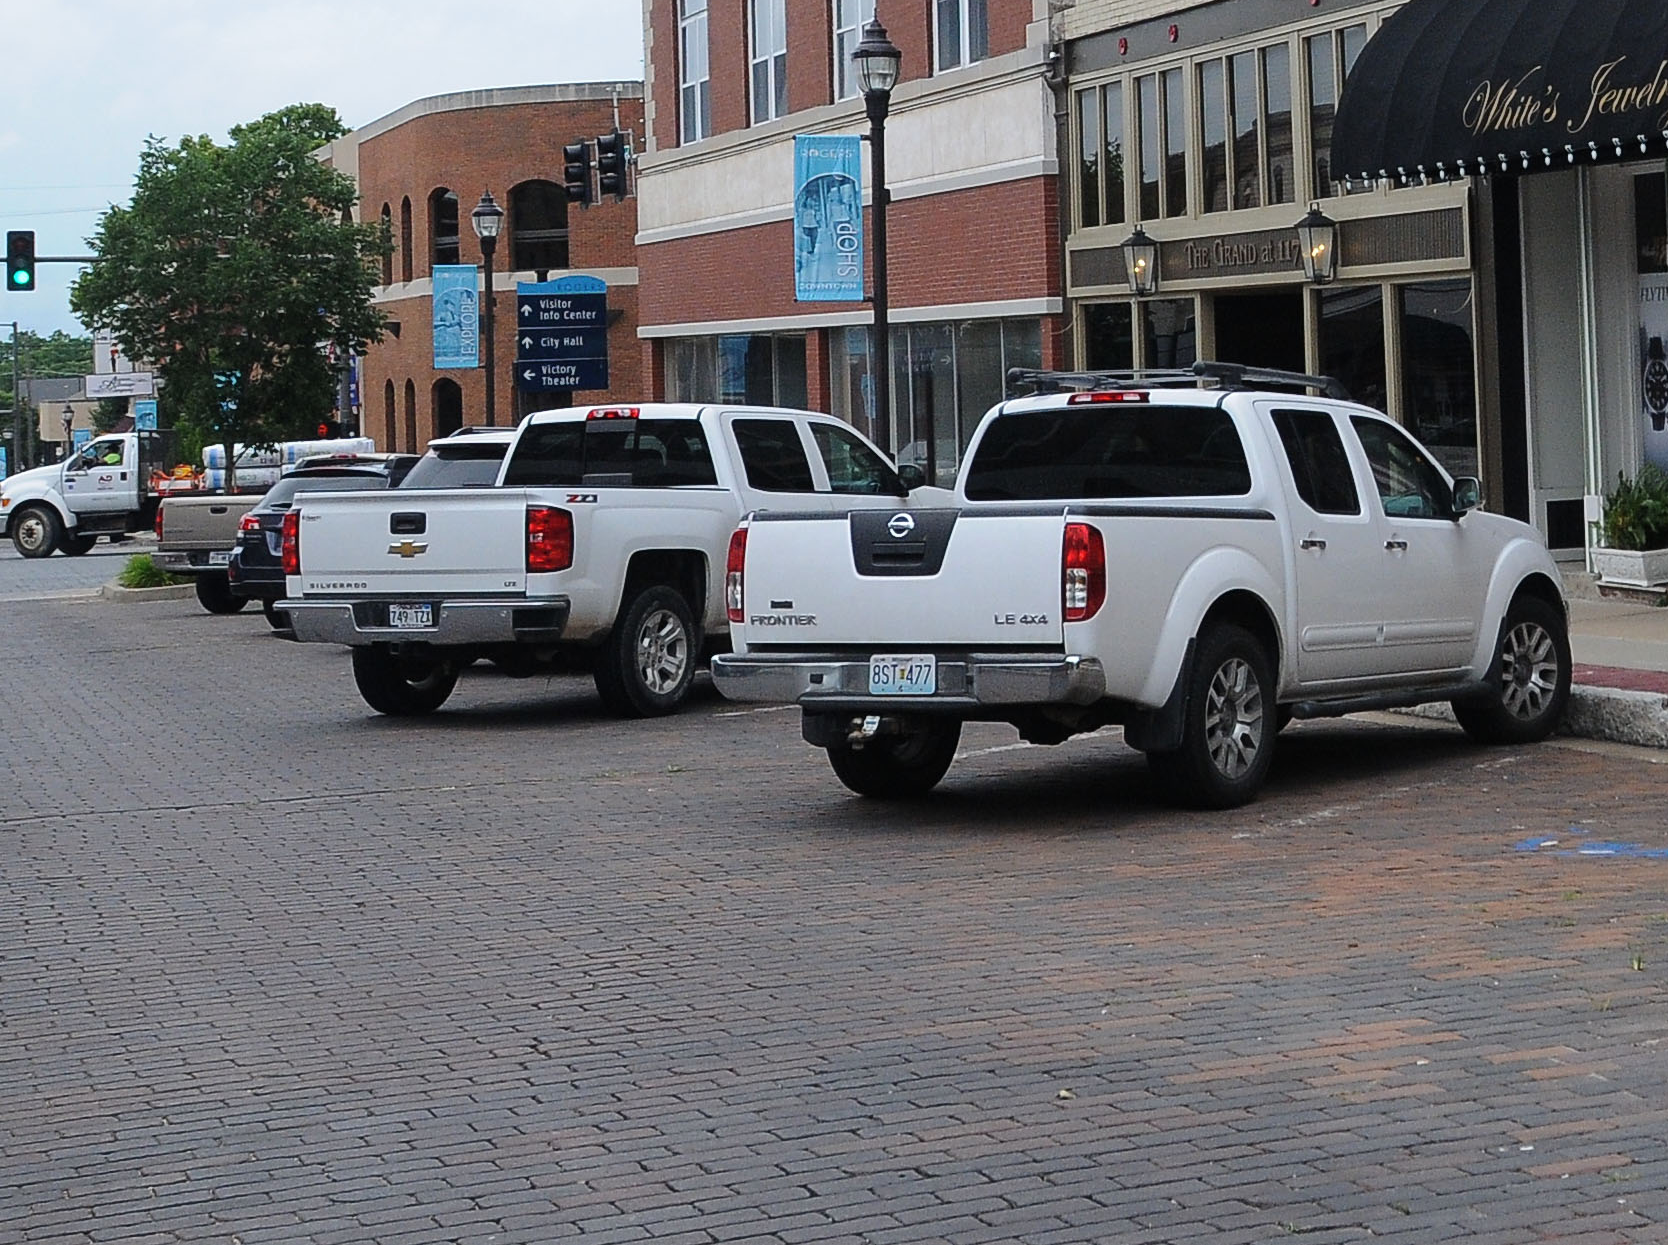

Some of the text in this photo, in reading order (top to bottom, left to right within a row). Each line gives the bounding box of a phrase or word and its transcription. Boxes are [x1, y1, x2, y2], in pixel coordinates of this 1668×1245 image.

[1462, 65, 1560, 137] White's
[837, 222, 858, 277] SHOP
[1212, 239, 1258, 266] GRAND
[1262, 242, 1275, 263] at
[1278, 238, 1301, 266] 117
[539, 299, 573, 309] Visitor
[539, 310, 597, 321] Info Center
[460, 296, 476, 355] EXPLORE
[540, 336, 584, 349] City Hall
[541, 364, 577, 376] Victory
[541, 376, 580, 386] Theater
[565, 493, 598, 504] Z71
[309, 582, 368, 590] SILVERADO
[391, 610, 409, 624] 749
[750, 614, 818, 627] FRONTIER
[993, 613, 1016, 625] LE
[872, 664, 932, 685] 8ST 477
